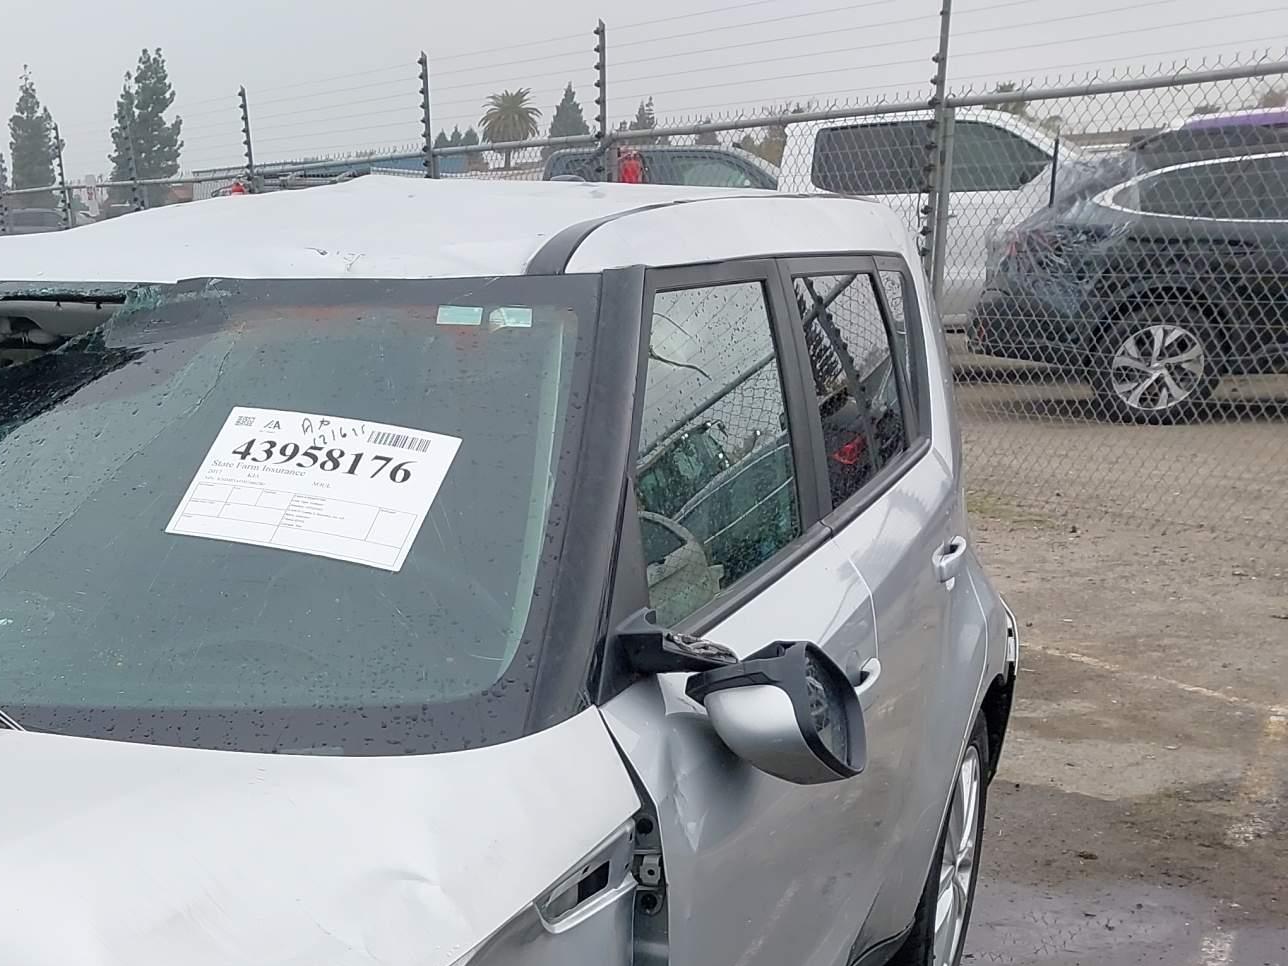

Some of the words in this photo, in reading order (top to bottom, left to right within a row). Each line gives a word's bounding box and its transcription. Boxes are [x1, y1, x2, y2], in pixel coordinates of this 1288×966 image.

[212, 460, 234, 468] State
[236, 462, 260, 471] Farm
[262, 465, 307, 477] Insurance
[231, 438, 418, 484] 43958176
